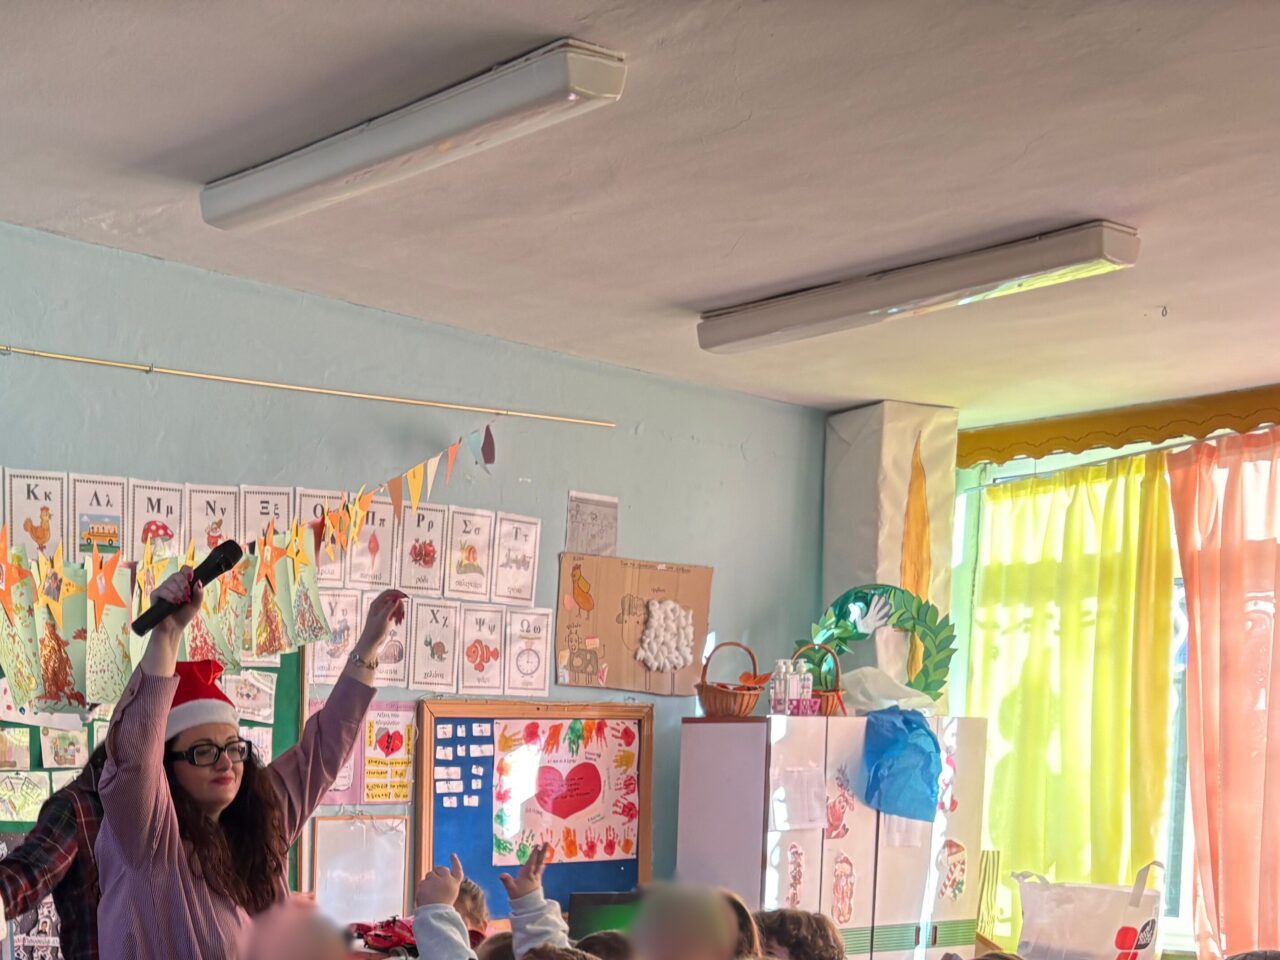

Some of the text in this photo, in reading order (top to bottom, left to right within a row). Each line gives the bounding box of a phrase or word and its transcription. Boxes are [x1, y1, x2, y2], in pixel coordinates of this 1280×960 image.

[25, 483, 39, 501] Κ
[89, 490, 102, 507] Λ
[146, 497, 161, 514] Μ
[205, 500, 217, 516] Ν
[259, 500, 270, 516] Ξ
[416, 512, 425, 528] Ρ
[462, 519, 472, 534] Σ
[512, 526, 522, 541] Τ
[328, 602, 338, 617] Υ
[429, 609, 440, 624] Χ
[475, 617, 486, 632] Ψ
[519, 618, 531, 633] Ω
